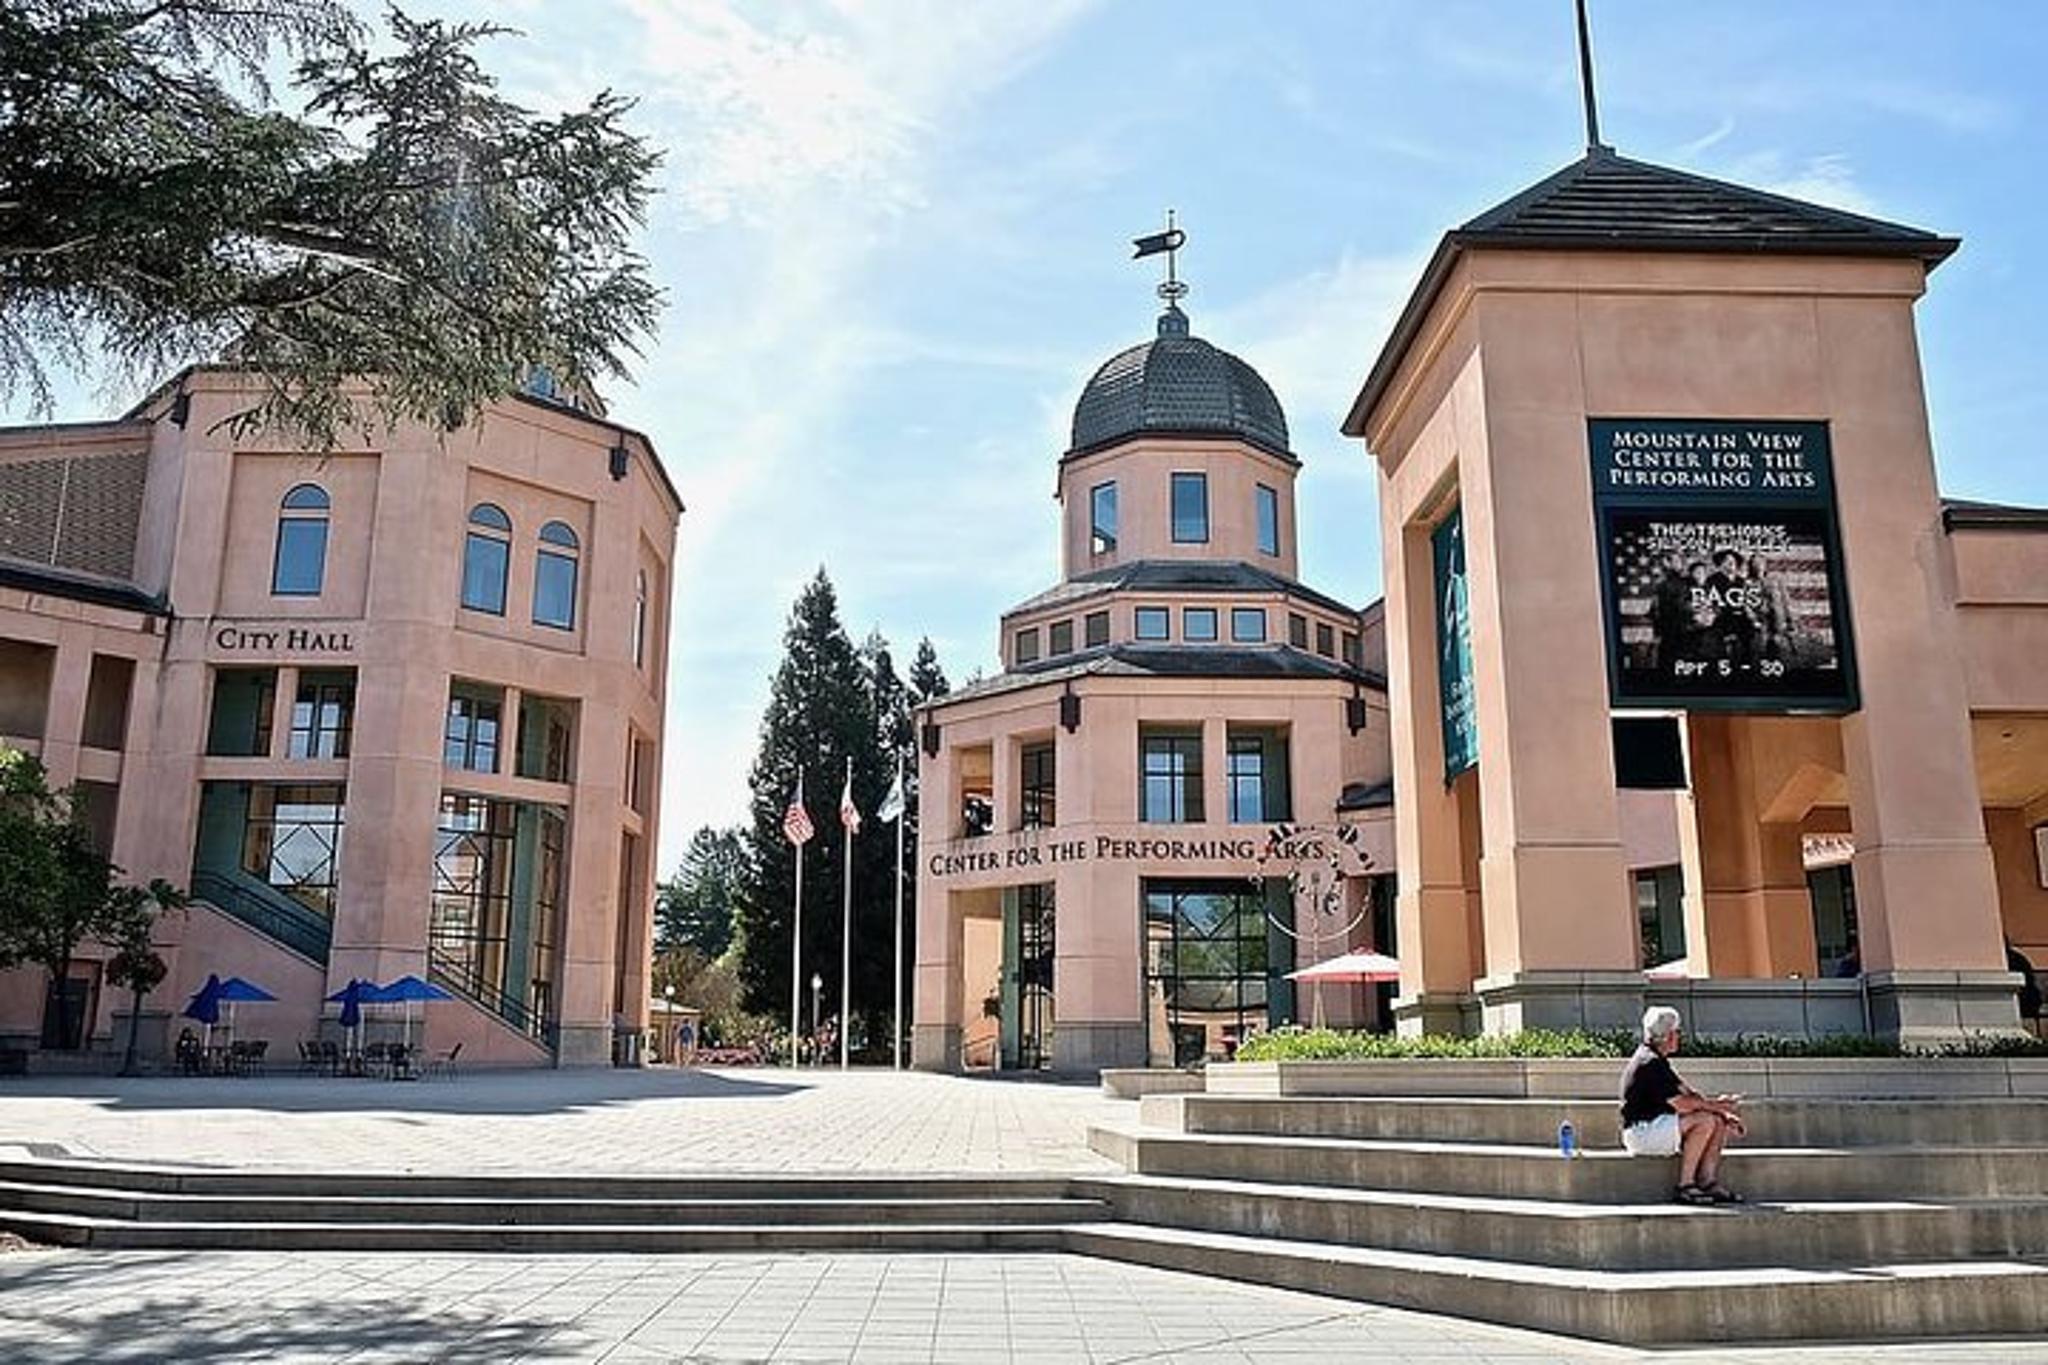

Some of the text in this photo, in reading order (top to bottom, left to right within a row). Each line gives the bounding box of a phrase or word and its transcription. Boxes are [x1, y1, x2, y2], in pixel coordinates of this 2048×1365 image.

[1612, 431, 1804, 449] MOUNTAIN VIEW
[1615, 450, 1804, 469] CENTER FOR THE
[1609, 468, 1816, 488] PERFORMING ARTS
[216, 628, 353, 651] CITY HALL
[1718, 659, 1732, 675] 5
[930, 835, 1325, 876] CENTER FOR THE PERFORMING ARTS
